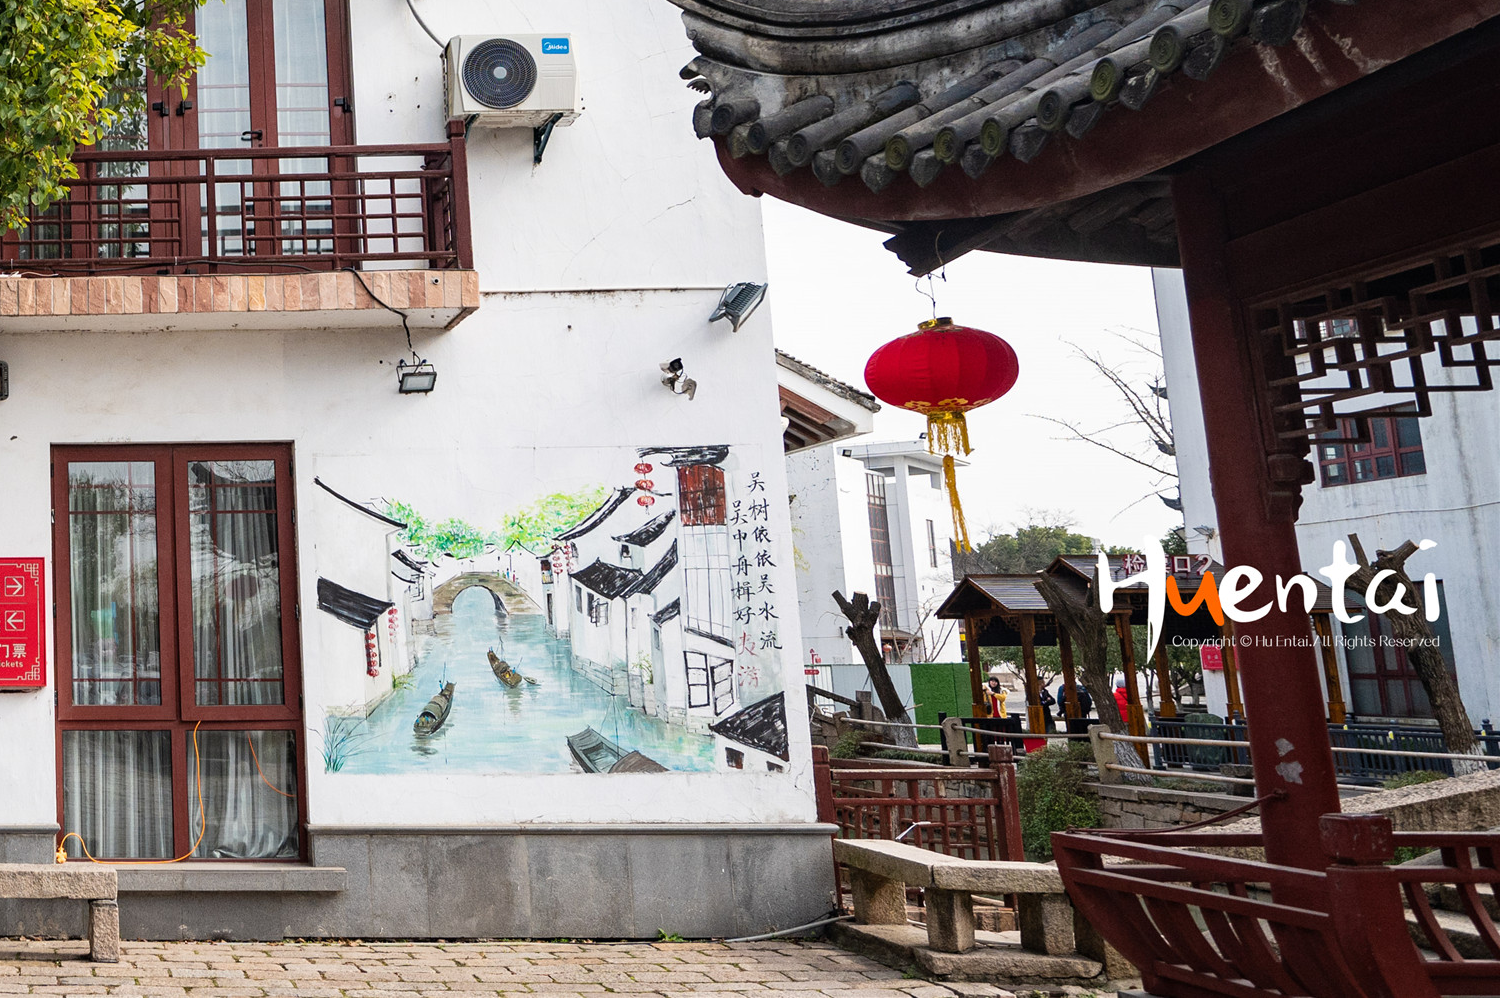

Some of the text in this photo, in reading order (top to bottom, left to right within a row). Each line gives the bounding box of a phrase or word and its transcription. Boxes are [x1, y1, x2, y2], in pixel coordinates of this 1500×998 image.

[543, 42, 568, 51] Midea
[747, 471, 783, 650] 吴树依依吴水流
[1123, 554, 1214, 577] 检口2
